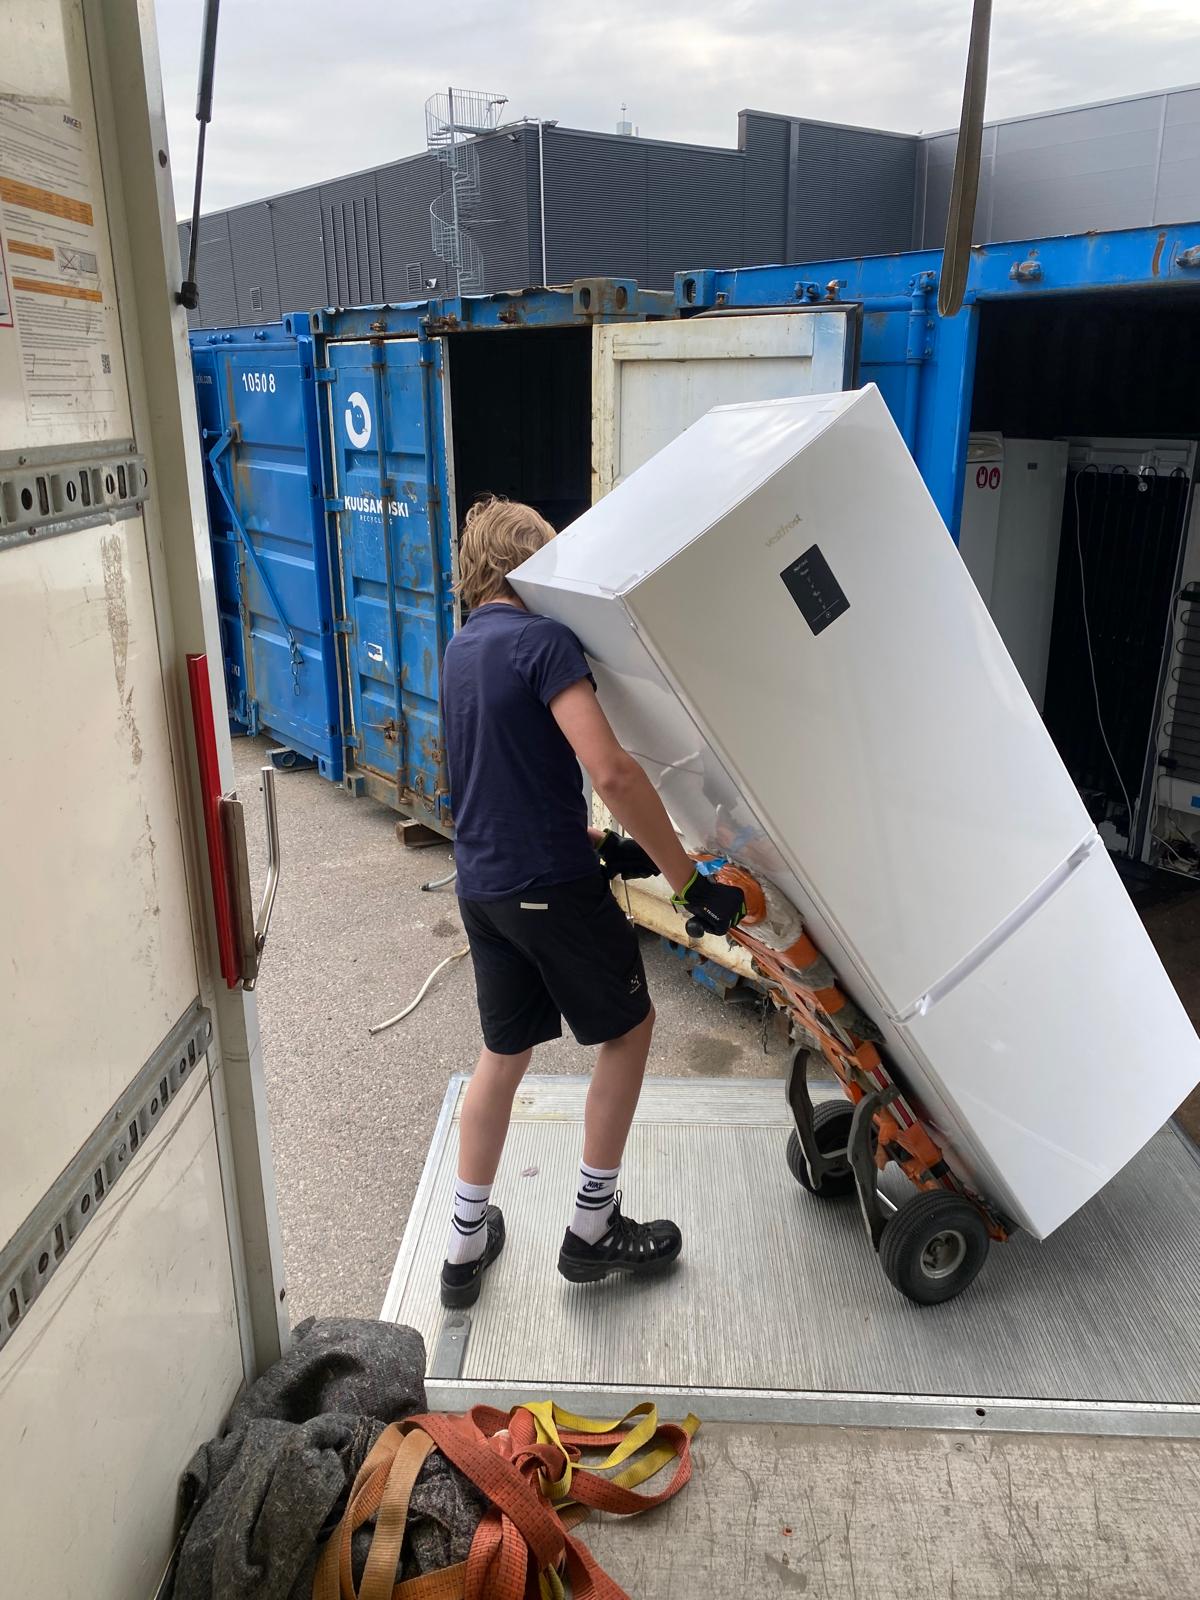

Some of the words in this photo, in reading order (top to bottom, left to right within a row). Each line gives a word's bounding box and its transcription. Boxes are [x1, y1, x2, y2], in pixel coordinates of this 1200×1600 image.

[242, 373, 276, 393] 10508
[345, 496, 409, 517] KUUSAKSKI
[360, 514, 393, 525] RECYCLG
